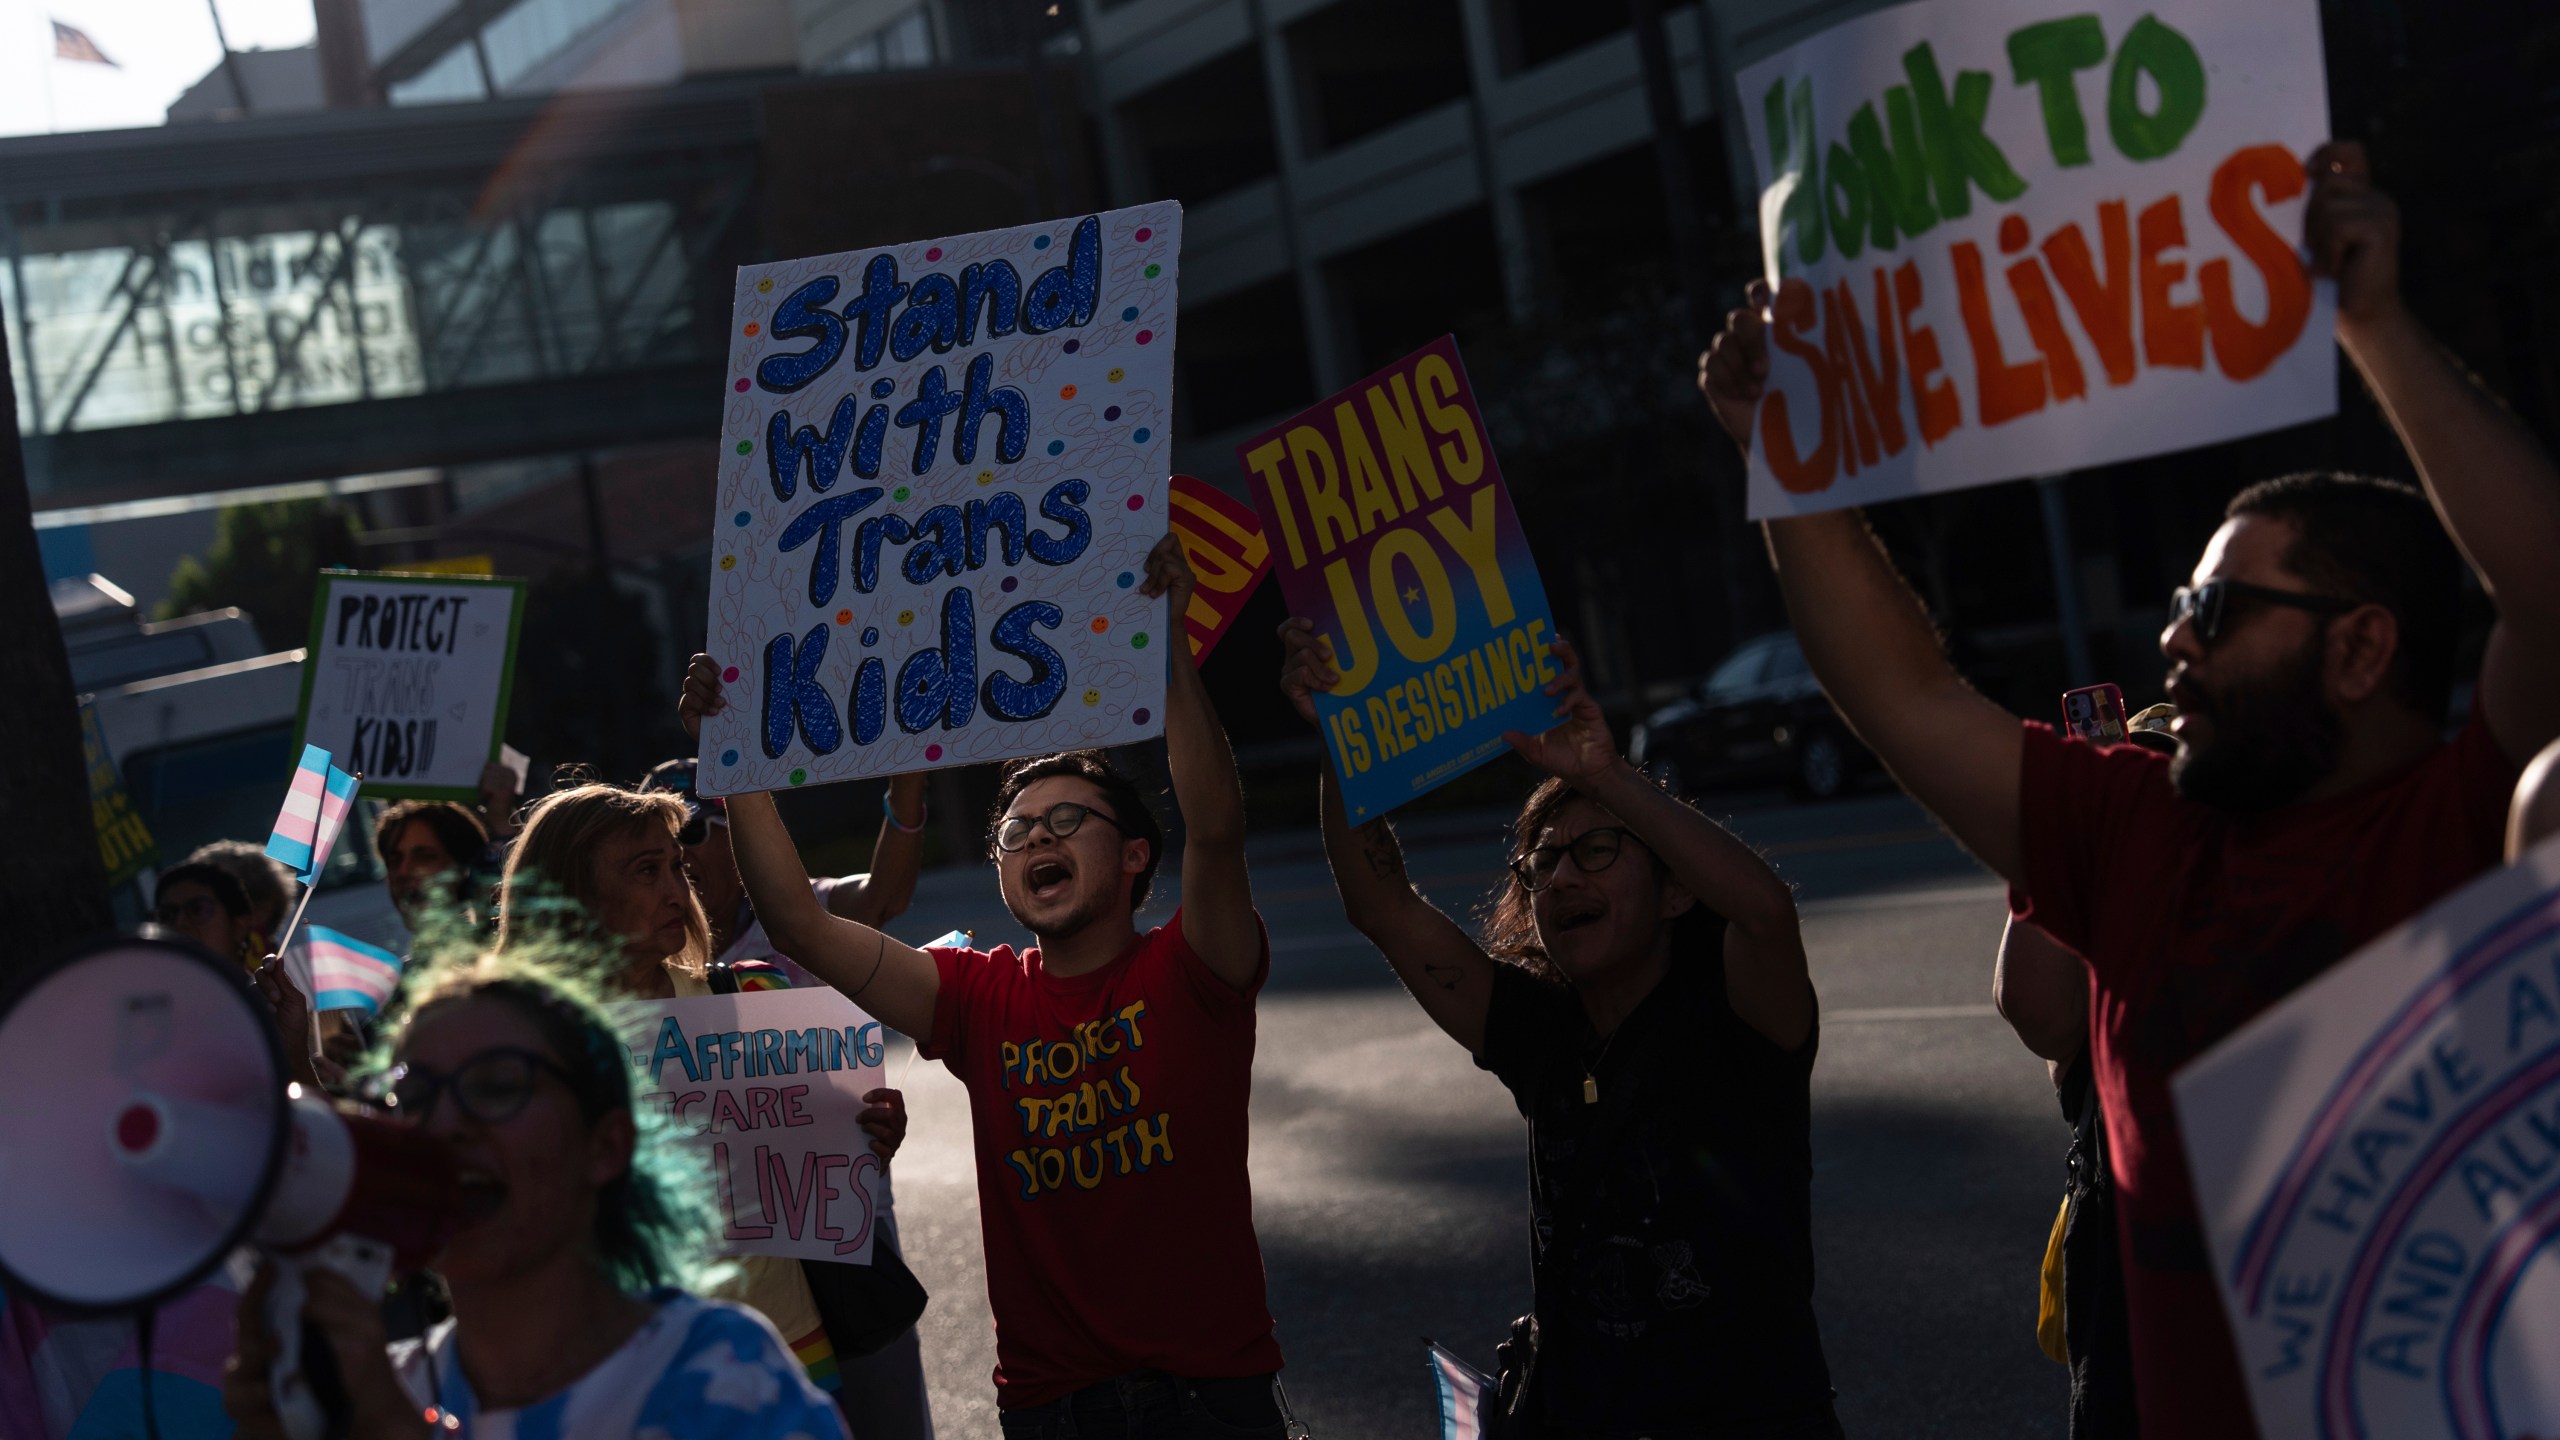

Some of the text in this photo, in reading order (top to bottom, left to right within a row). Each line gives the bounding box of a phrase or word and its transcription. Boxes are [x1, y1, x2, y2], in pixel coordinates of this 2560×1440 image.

[2007, 13, 2206, 168] TO
[757, 214, 1103, 394] Stand
[1761, 262, 1961, 494] SAVE
[1246, 353, 1485, 570] TRANS
[777, 478, 1093, 608] Trans
[1316, 483, 1517, 697] JOY
[335, 655, 441, 716] TRANS
[336, 593, 468, 654] PROTECT
[1328, 618, 1558, 778] IS RESISTANCE
[1001, 998, 1147, 1091] PROTECT
[1014, 1065, 1143, 1140] TRANS
[713, 1141, 880, 1256] LIVES
[1005, 1111, 1176, 1201] YOUTH
[2262, 1268, 2330, 1380] WE
[2312, 1040, 2484, 1234] HAVE
[2364, 1229, 2468, 1380] AND
